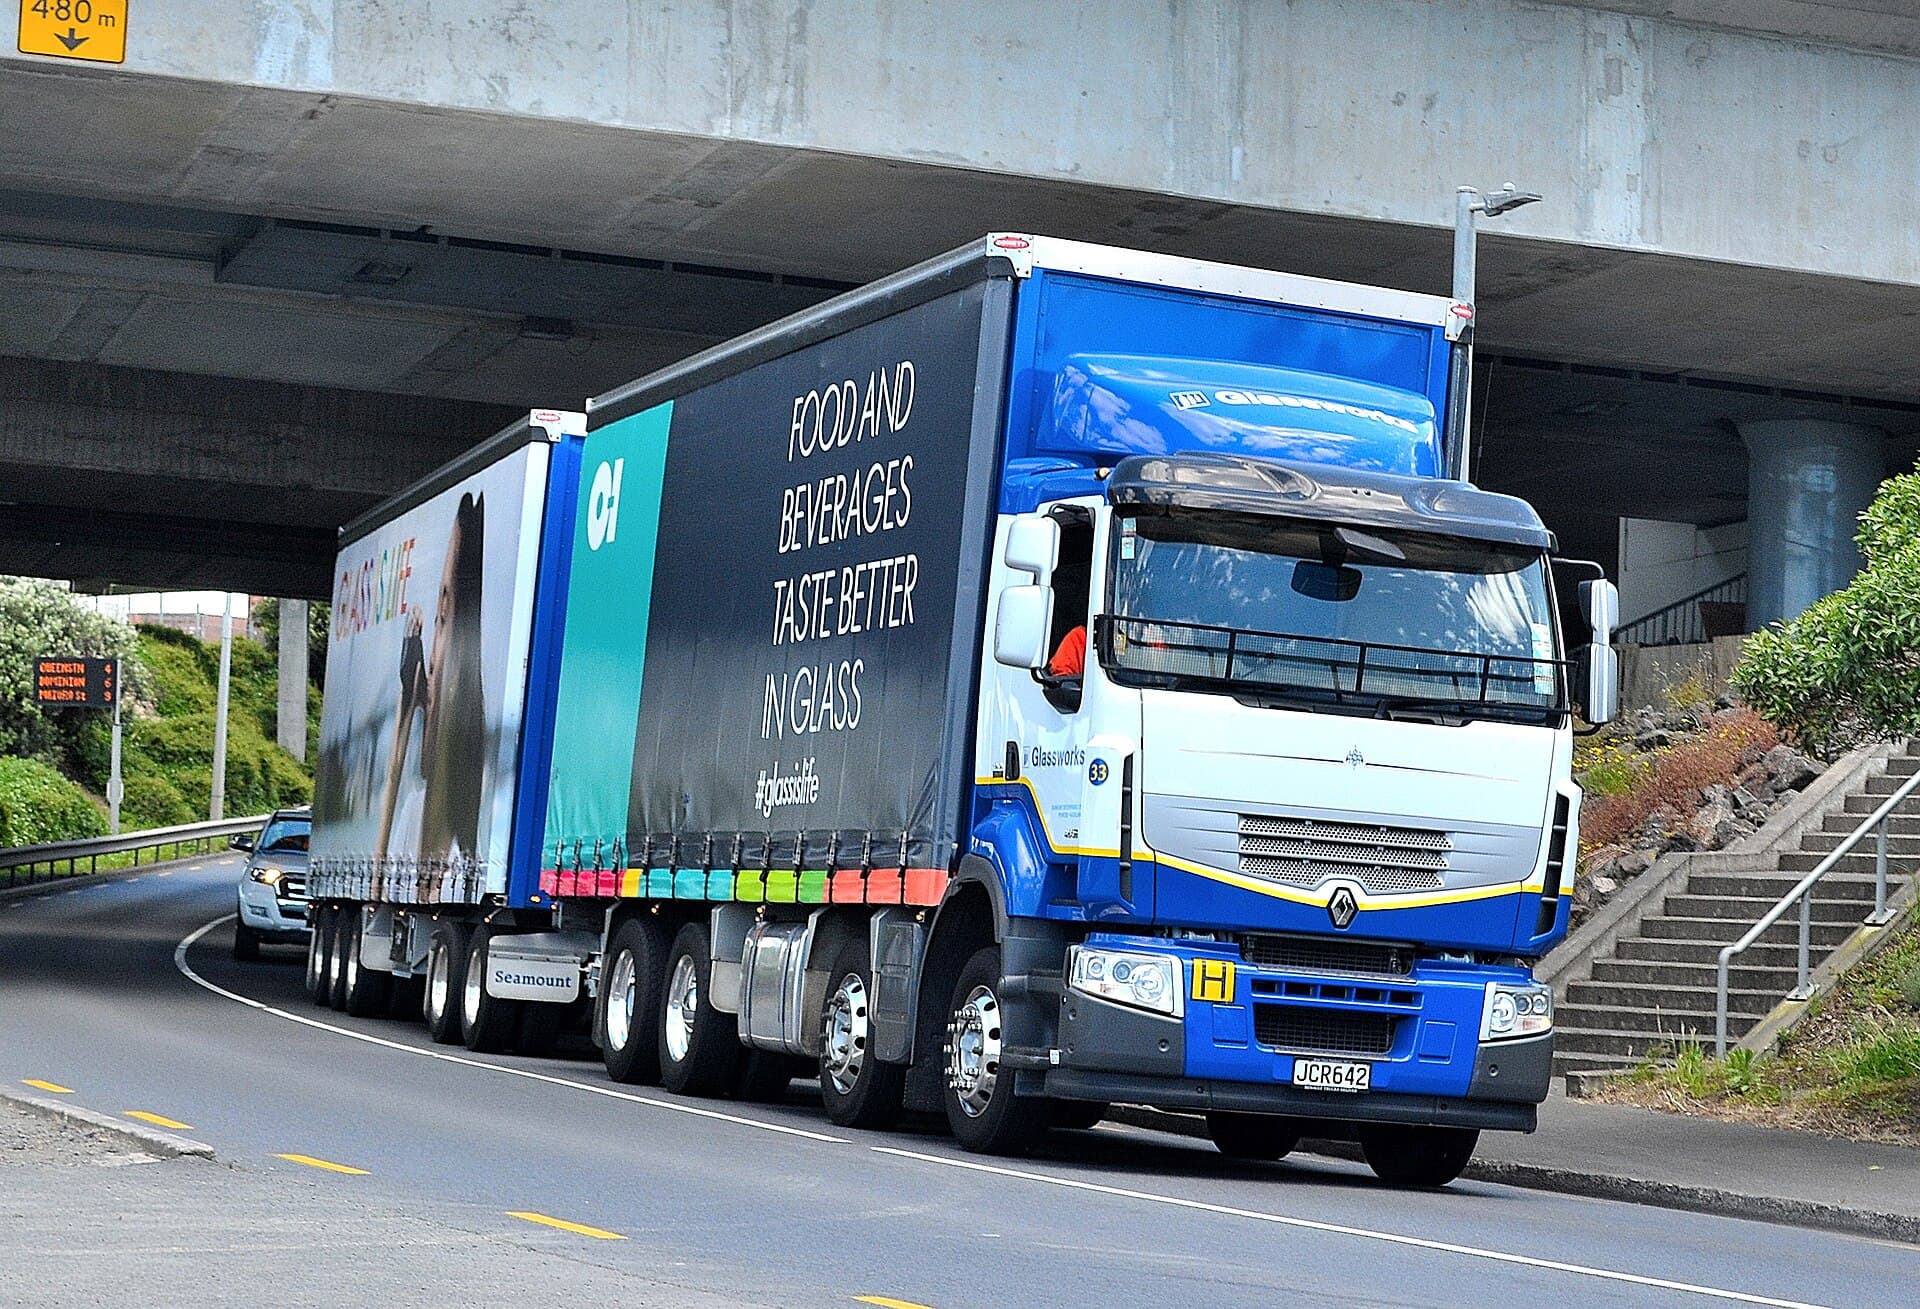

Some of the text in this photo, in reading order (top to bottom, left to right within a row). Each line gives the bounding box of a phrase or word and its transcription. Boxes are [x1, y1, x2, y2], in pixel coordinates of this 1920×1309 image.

[98, 14, 116, 28] m
[787, 360, 916, 462] FOOD AND
[778, 454, 914, 554] BEVERAGES
[772, 553, 919, 646] TASTE BETTER
[761, 658, 864, 741] IN GLASS
[1031, 744, 1086, 767] Glassworks
[1090, 764, 1107, 781] 33
[755, 756, 819, 818] #glassislife
[495, 970, 572, 988] Seamount
[1200, 960, 1227, 1000] H
[1296, 1063, 1367, 1086] JCR642
